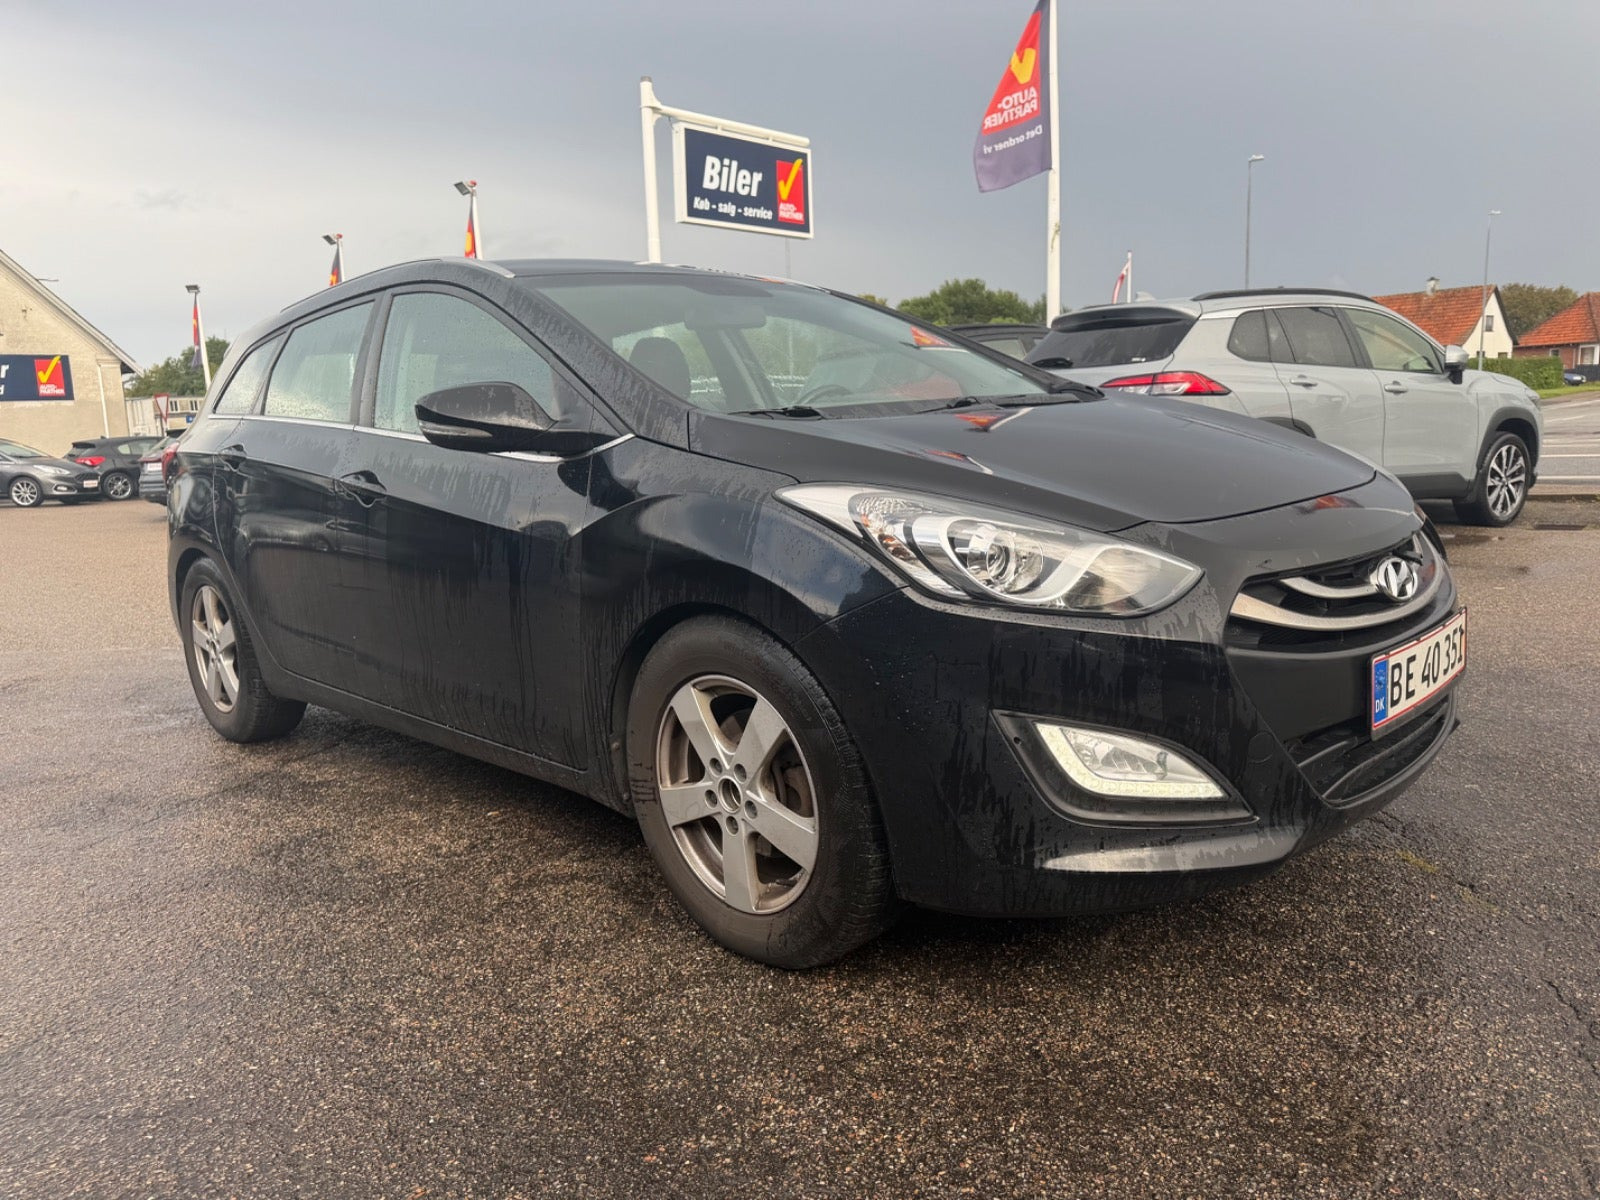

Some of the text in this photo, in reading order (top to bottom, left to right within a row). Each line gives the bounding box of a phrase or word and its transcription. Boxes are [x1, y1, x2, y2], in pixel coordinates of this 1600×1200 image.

[702, 155, 763, 197] Biler
[718, 202, 737, 217] salg
[743, 206, 773, 220] service
[1390, 654, 1416, 708] BE
[1421, 641, 1440, 689] 40
[1375, 697, 1385, 713] DK
